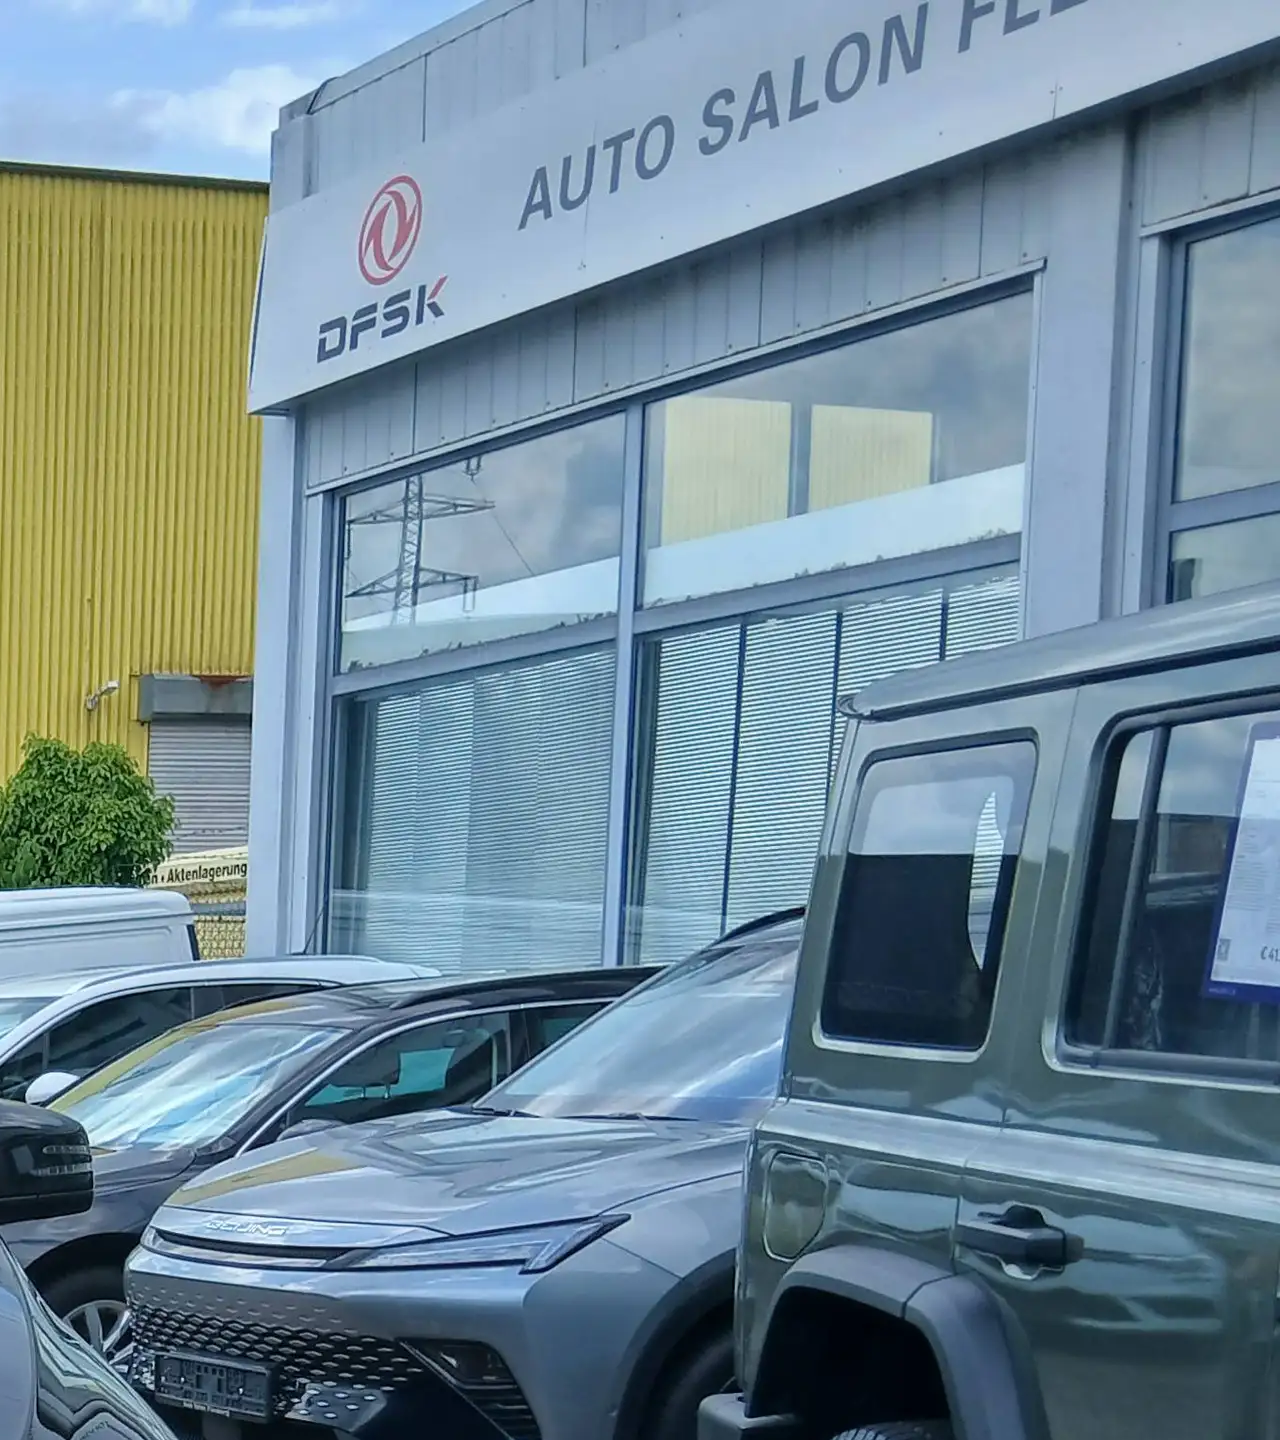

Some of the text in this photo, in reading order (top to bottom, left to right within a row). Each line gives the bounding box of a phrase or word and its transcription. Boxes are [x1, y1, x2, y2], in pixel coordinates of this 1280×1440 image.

[517, 115, 675, 231] AUTO
[697, 2, 929, 157] SALON
[316, 275, 448, 363] DFSK
[167, 863, 248, 884] Aktenlagerung
